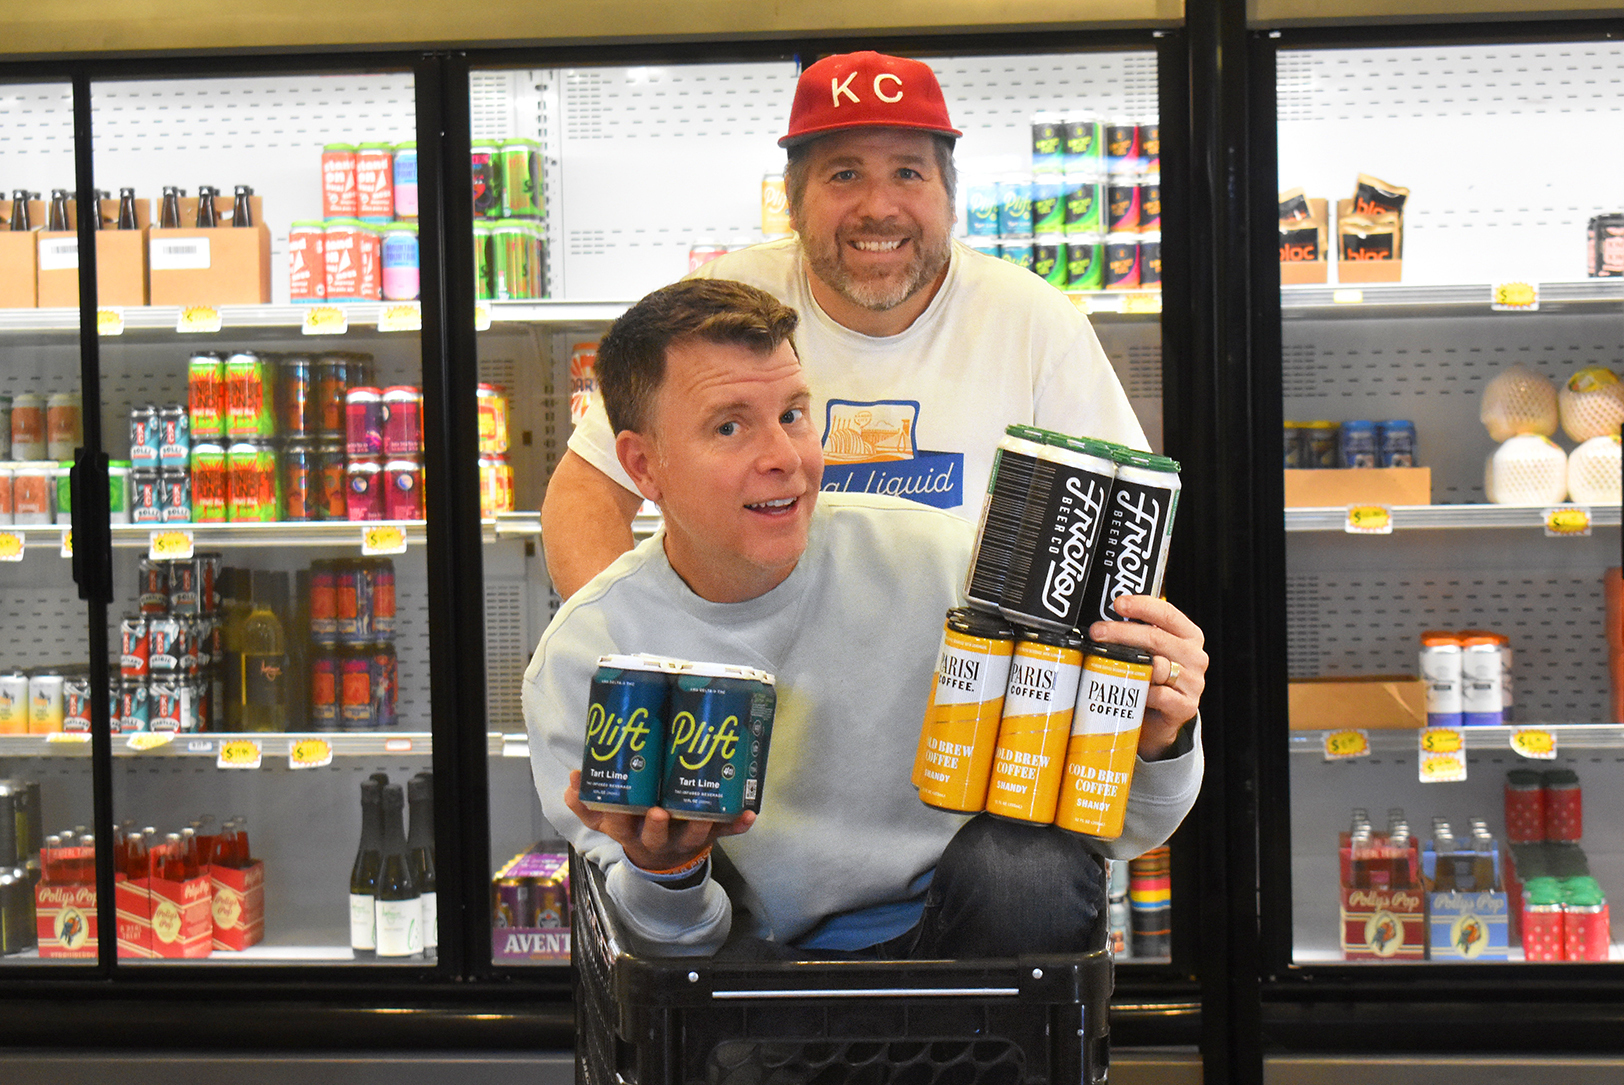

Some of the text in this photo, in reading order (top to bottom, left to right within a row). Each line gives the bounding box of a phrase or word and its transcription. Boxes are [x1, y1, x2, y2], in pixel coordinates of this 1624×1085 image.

[864, 462, 954, 498] liquid
[1048, 496, 1073, 555] BEER CO
[1042, 477, 1105, 618] Friction
[1103, 509, 1124, 567] BEER CO
[1088, 680, 1140, 708] PARISI
[586, 703, 650, 761] Plift
[671, 711, 739, 770] Plift
[938, 740, 974, 757] BREW
[1014, 751, 1051, 768] BREW
[590, 769, 628, 780] Tart Lime
[997, 761, 1036, 780] COFFEE
[1069, 763, 1129, 784] COLD BREW
[679, 777, 720, 789] Tart Lime
[997, 781, 1027, 794] SHANDY
[1075, 779, 1118, 797] COFFEE
[1077, 798, 1110, 812] SHANDY
[39, 888, 75, 908] Polly's
[1349, 891, 1420, 912] Polly's Pop
